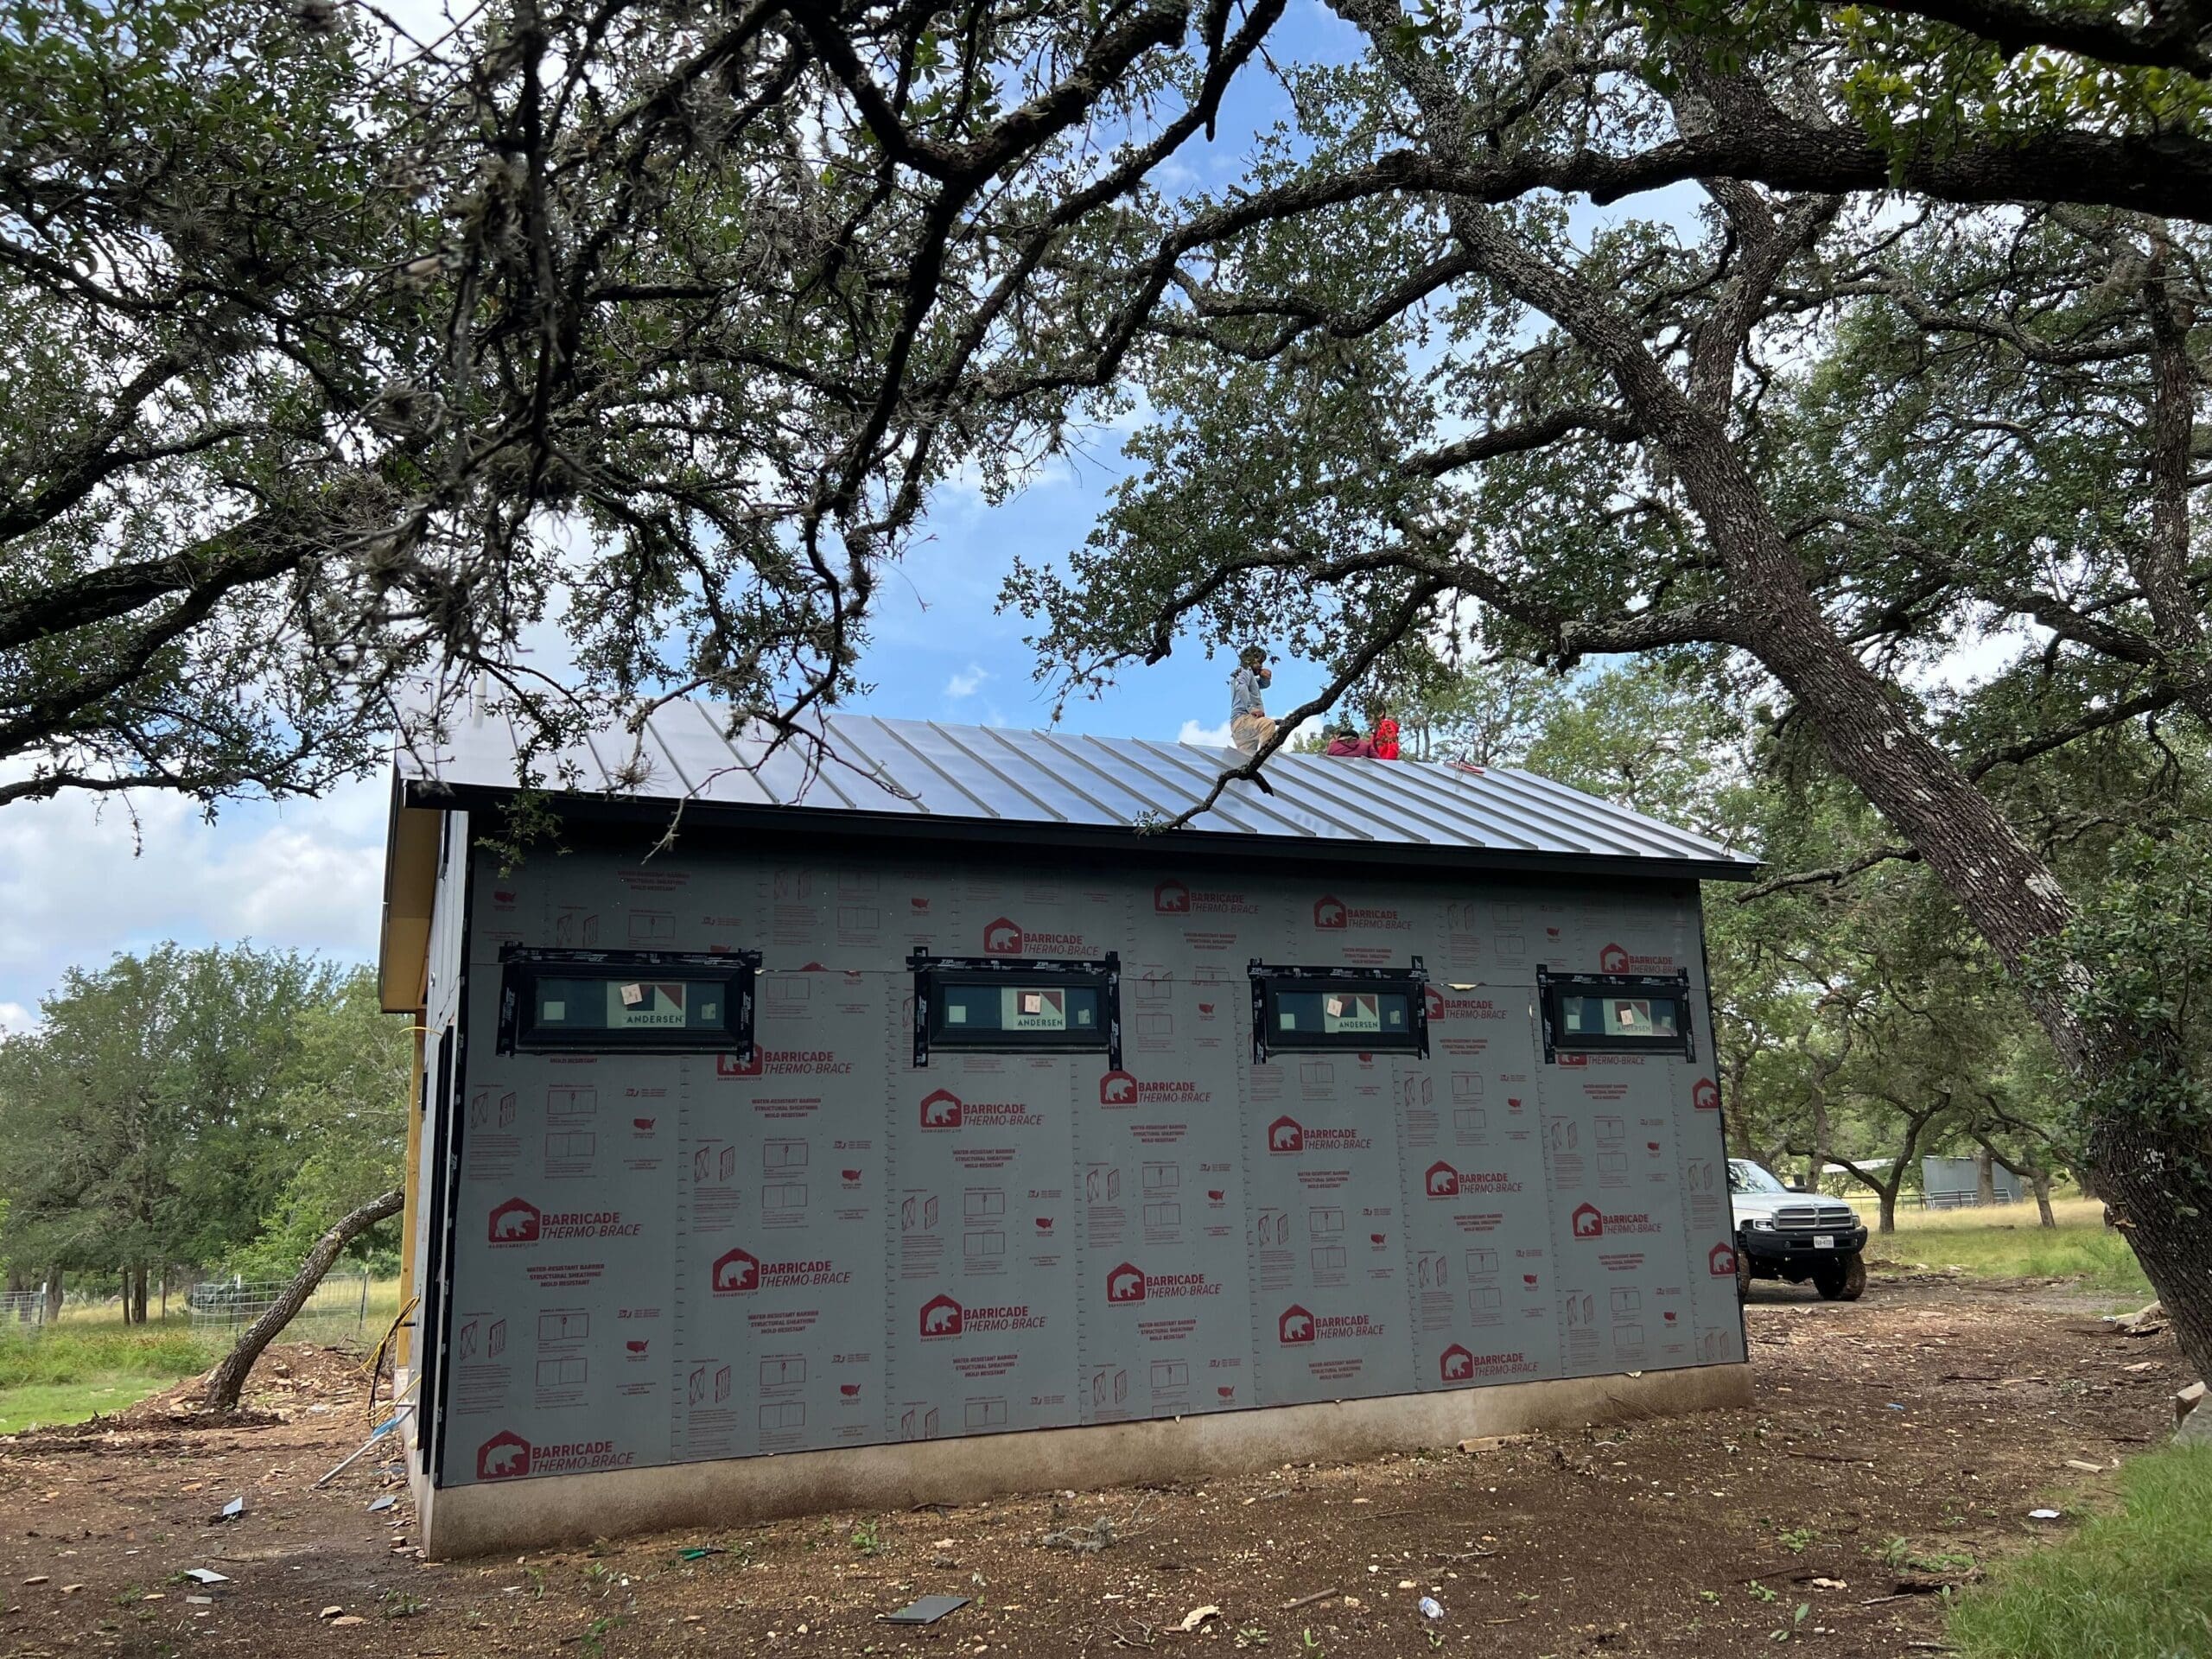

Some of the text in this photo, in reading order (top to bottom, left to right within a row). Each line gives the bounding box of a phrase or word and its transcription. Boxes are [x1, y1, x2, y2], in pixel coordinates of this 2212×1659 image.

[1191, 893, 1244, 903] BARRICADE
[1192, 903, 1259, 913] THERMO-BRACE
[1348, 909, 1397, 919] BARRICADE
[1348, 918, 1412, 930] THERMO-BRACE
[1024, 933, 1083, 944] BARRICADE
[1023, 944, 1099, 956] THERMO-BRACE
[1630, 956, 1673, 964] BARRICADE
[1445, 1001, 1493, 1009] BARRICADE
[1446, 1009, 1507, 1020] THERMO-BRACE
[765, 1052, 833, 1062] BARRICADE
[764, 1064, 852, 1074] THERMO-BRACE
[1139, 1082, 1196, 1091] BARRICADE
[1139, 1092, 1211, 1103] THERMO-BRACE
[963, 1104, 1026, 1114] BARRICADE
[963, 1115, 1042, 1125] THERMO-BRACE
[1304, 1129, 1357, 1139] BARRICADE
[1305, 1140, 1371, 1149] THERMO-BRACE
[1459, 1173, 1508, 1183] BARRICADE
[1460, 1183, 1522, 1193] THERMO-BRACE
[543, 1213, 620, 1225] BARRICADE
[1603, 1214, 1649, 1224] BARRICADE
[542, 1224, 640, 1239] THERMO-BRACE
[1604, 1224, 1662, 1234] THERMO-BRACE
[761, 1262, 831, 1274] BARRICADE
[760, 1273, 851, 1287] THERMO-BRACE
[1147, 1274, 1205, 1286] BARRICADE
[1147, 1284, 1222, 1298] THERMO-BRACE
[964, 1306, 1028, 1319] BARRICADE
[963, 1317, 1046, 1332] THERMO-BRACE
[1316, 1315, 1369, 1327] BARRICADE
[1317, 1325, 1384, 1338] THERMO-BRACE
[1474, 1353, 1523, 1365] BARRICADE
[1475, 1362, 1538, 1377] THERMO-BRACE
[532, 1441, 613, 1459] BARRICADE
[532, 1452, 634, 1472] THERMO-BRACE
